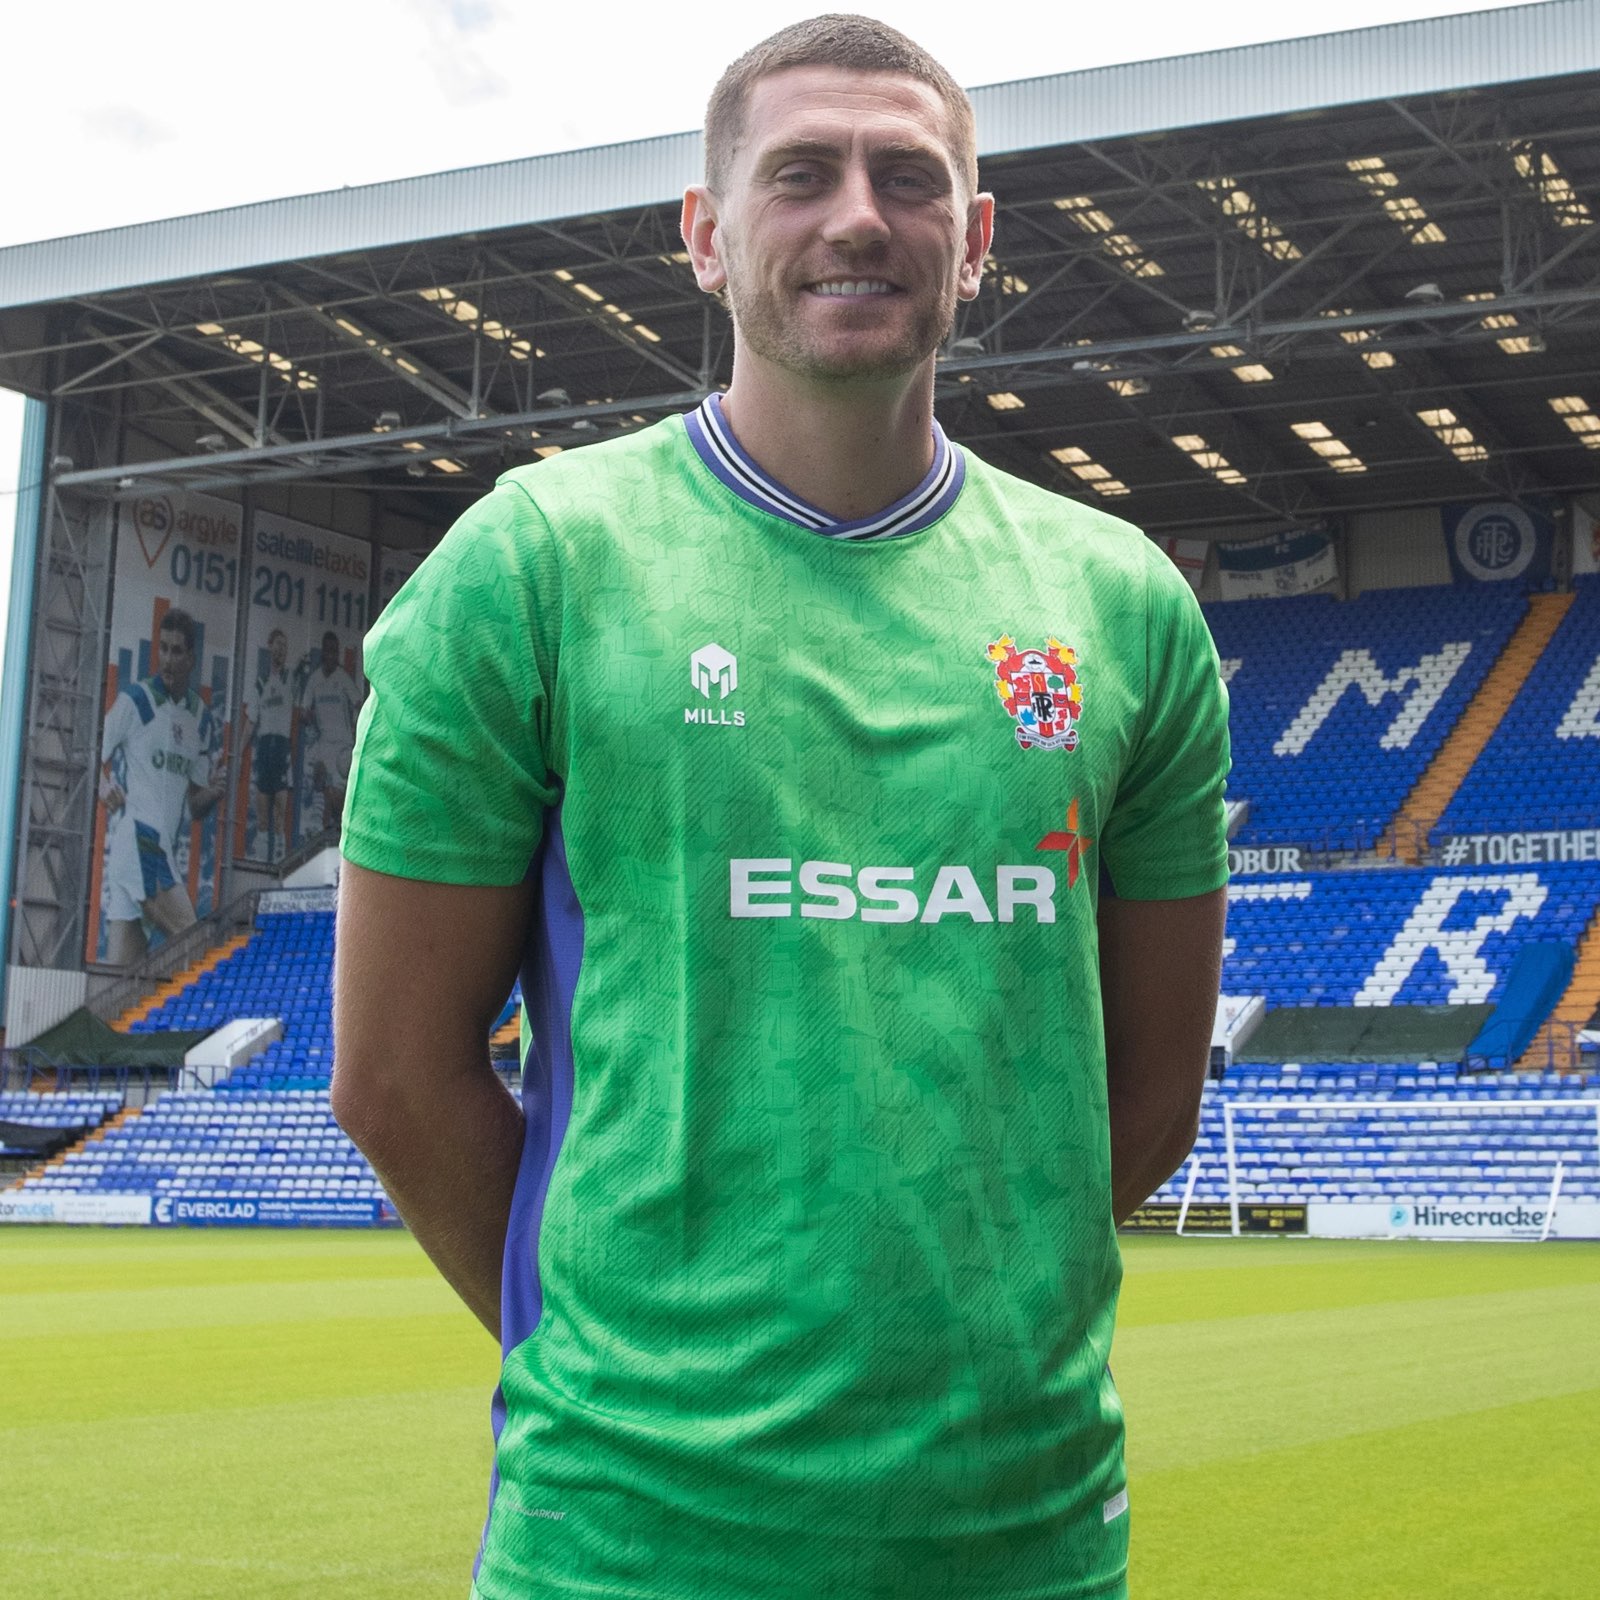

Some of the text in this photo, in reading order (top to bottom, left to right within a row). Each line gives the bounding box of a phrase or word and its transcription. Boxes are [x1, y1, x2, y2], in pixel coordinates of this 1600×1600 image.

[177, 510, 238, 546] argyle
[171, 544, 237, 598] 0151
[253, 565, 366, 632] 201 1111
[684, 708, 746, 727] MILLS
[730, 858, 1056, 923] ESSAR
[177, 1202, 256, 1218] EVERCLAD
